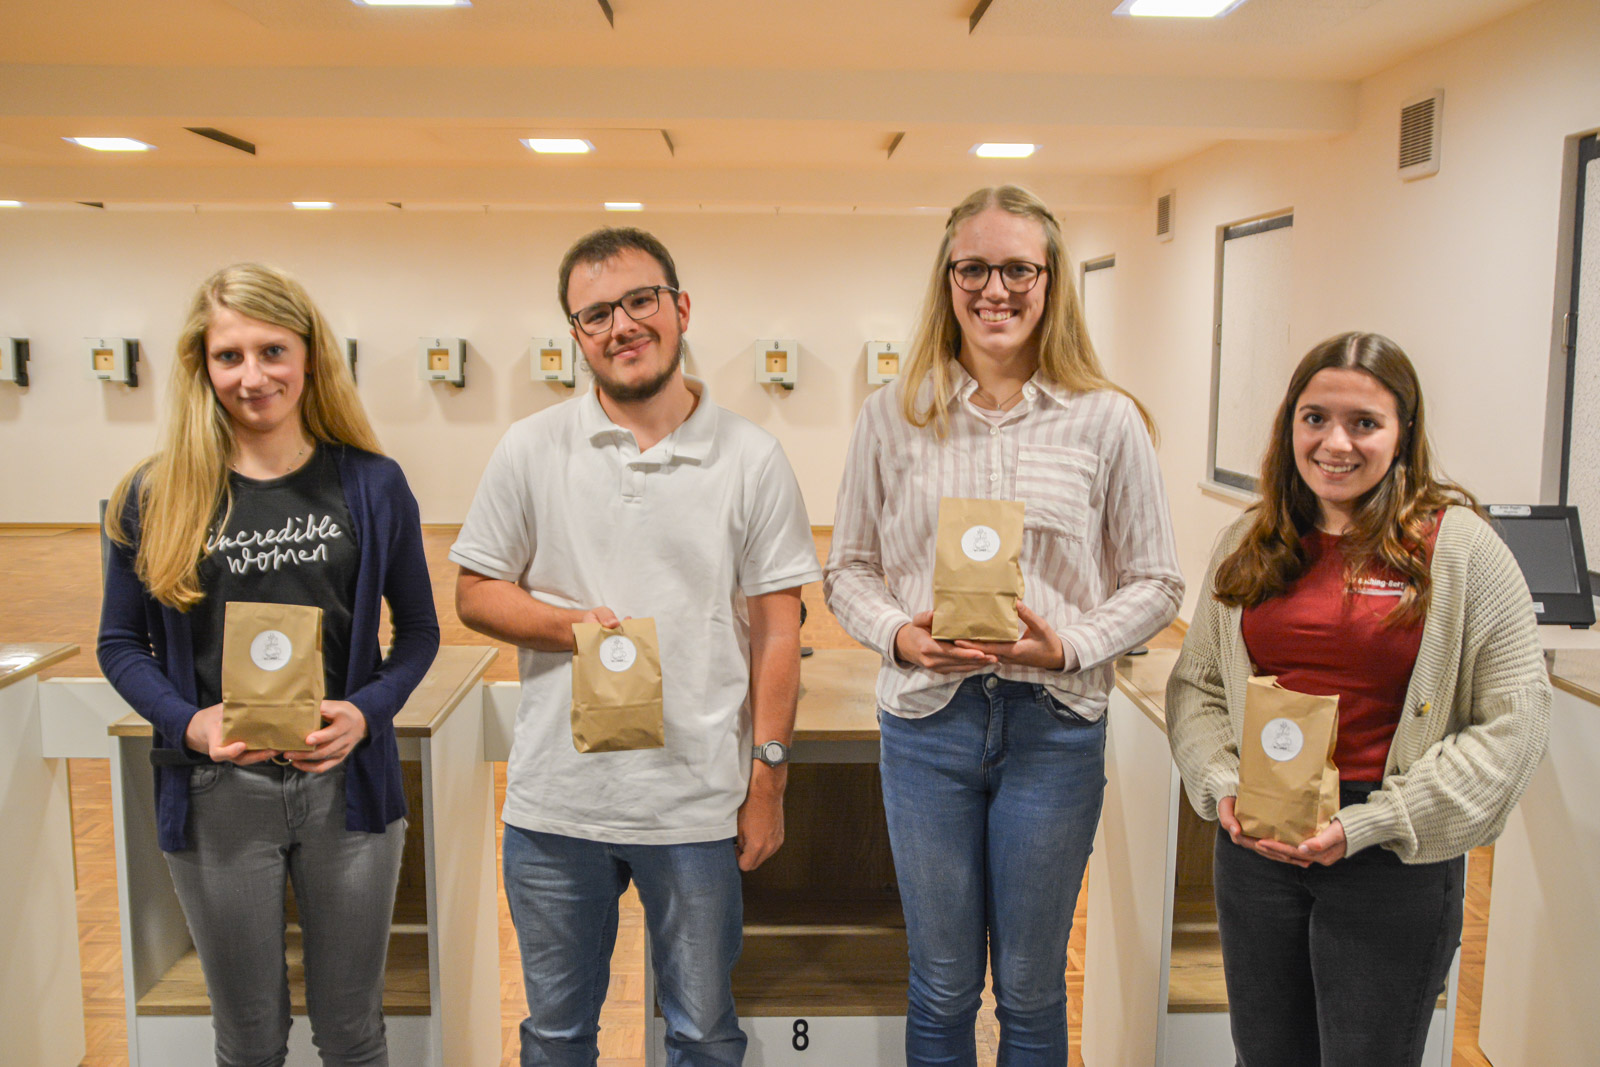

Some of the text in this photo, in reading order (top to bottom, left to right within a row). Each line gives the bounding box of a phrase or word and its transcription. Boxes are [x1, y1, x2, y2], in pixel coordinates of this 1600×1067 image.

[435, 338, 441, 347] 5
[548, 338, 554, 348] 6
[774, 341, 779, 350] 8
[886, 342, 892, 351] 9
[207, 513, 343, 551] incredible
[226, 544, 328, 574] women
[792, 1019, 809, 1051] 8
